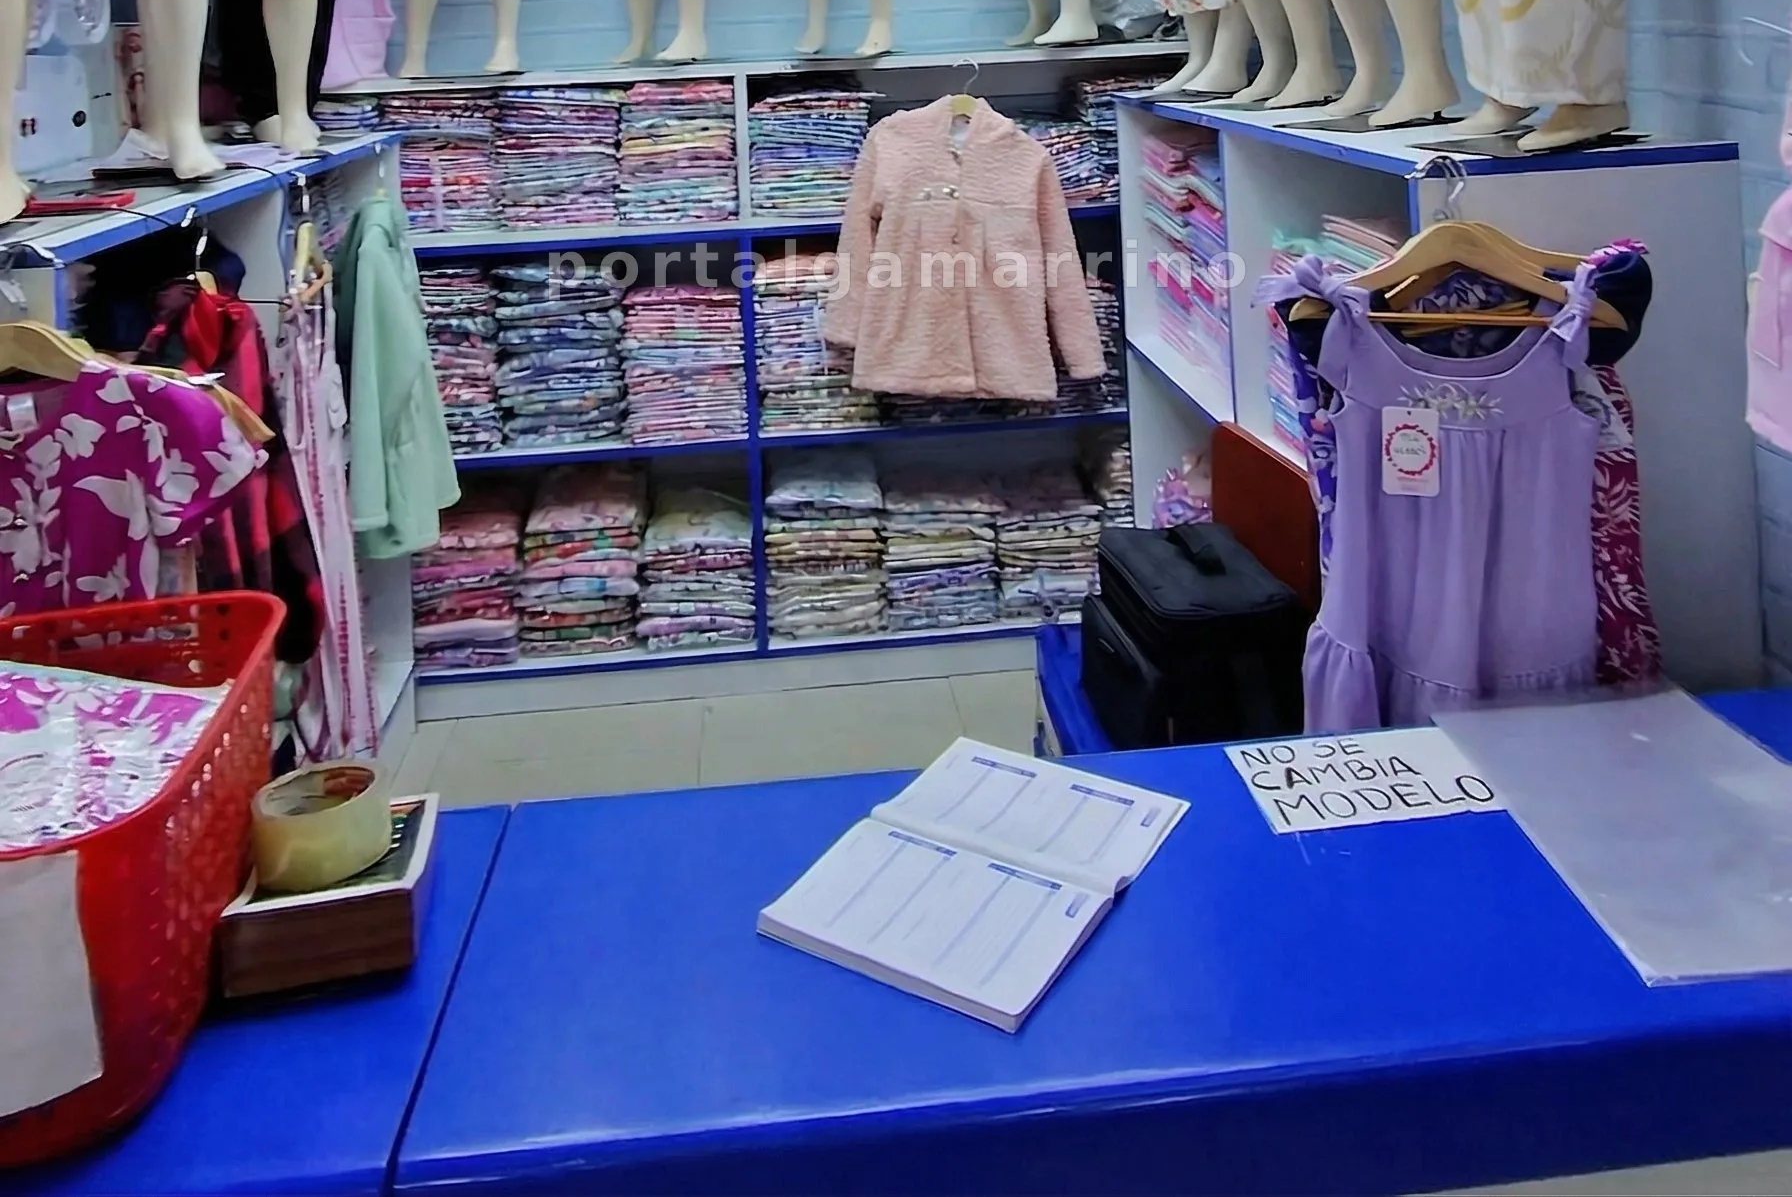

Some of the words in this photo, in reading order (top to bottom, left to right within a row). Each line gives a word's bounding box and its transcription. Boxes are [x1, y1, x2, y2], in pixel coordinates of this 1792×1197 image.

[1240, 744, 1296, 768] NO
[1312, 737, 1366, 758] SE
[1250, 755, 1422, 791] CAMBIA
[1272, 774, 1495, 827] MODELO
